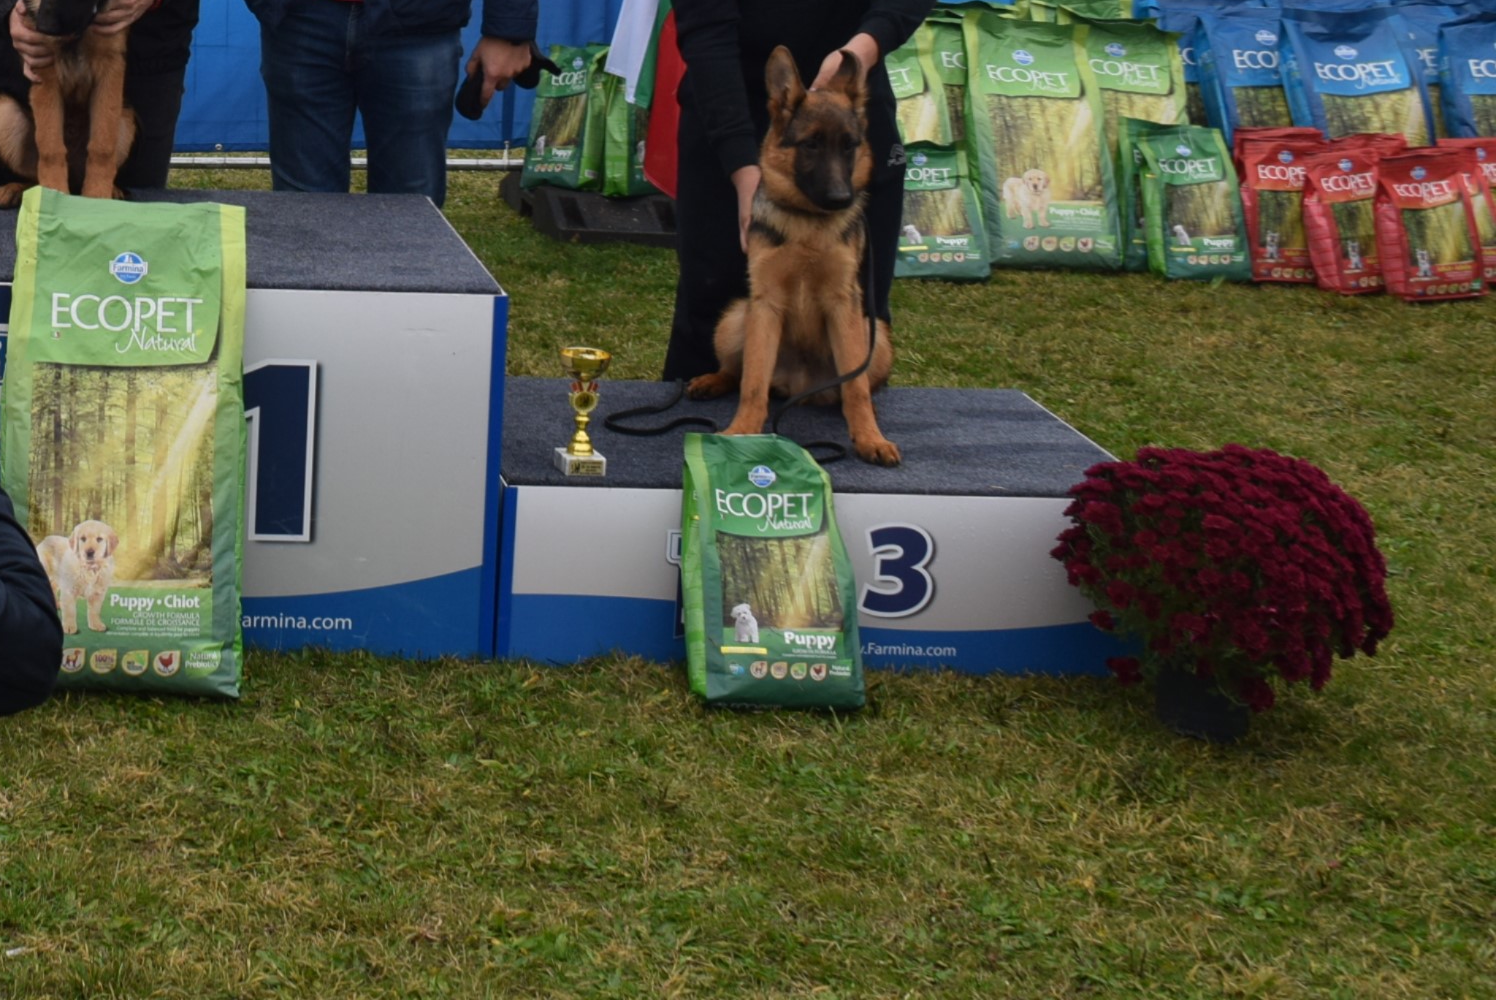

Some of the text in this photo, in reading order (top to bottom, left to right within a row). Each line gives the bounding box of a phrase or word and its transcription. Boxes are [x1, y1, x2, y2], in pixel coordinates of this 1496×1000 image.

[985, 64, 1068, 87] ECOPET
[1089, 58, 1160, 82] COPET
[1313, 60, 1395, 82] ECOPET
[51, 292, 204, 333] ECOPET
[115, 325, 198, 353] Natural
[243, 359, 318, 543] 1
[715, 488, 814, 518] ECOPET
[857, 522, 935, 618] 3
[110, 594, 201, 611] Puppy Chiot
[241, 612, 354, 631] armina.com
[783, 631, 837, 650] Puppy
